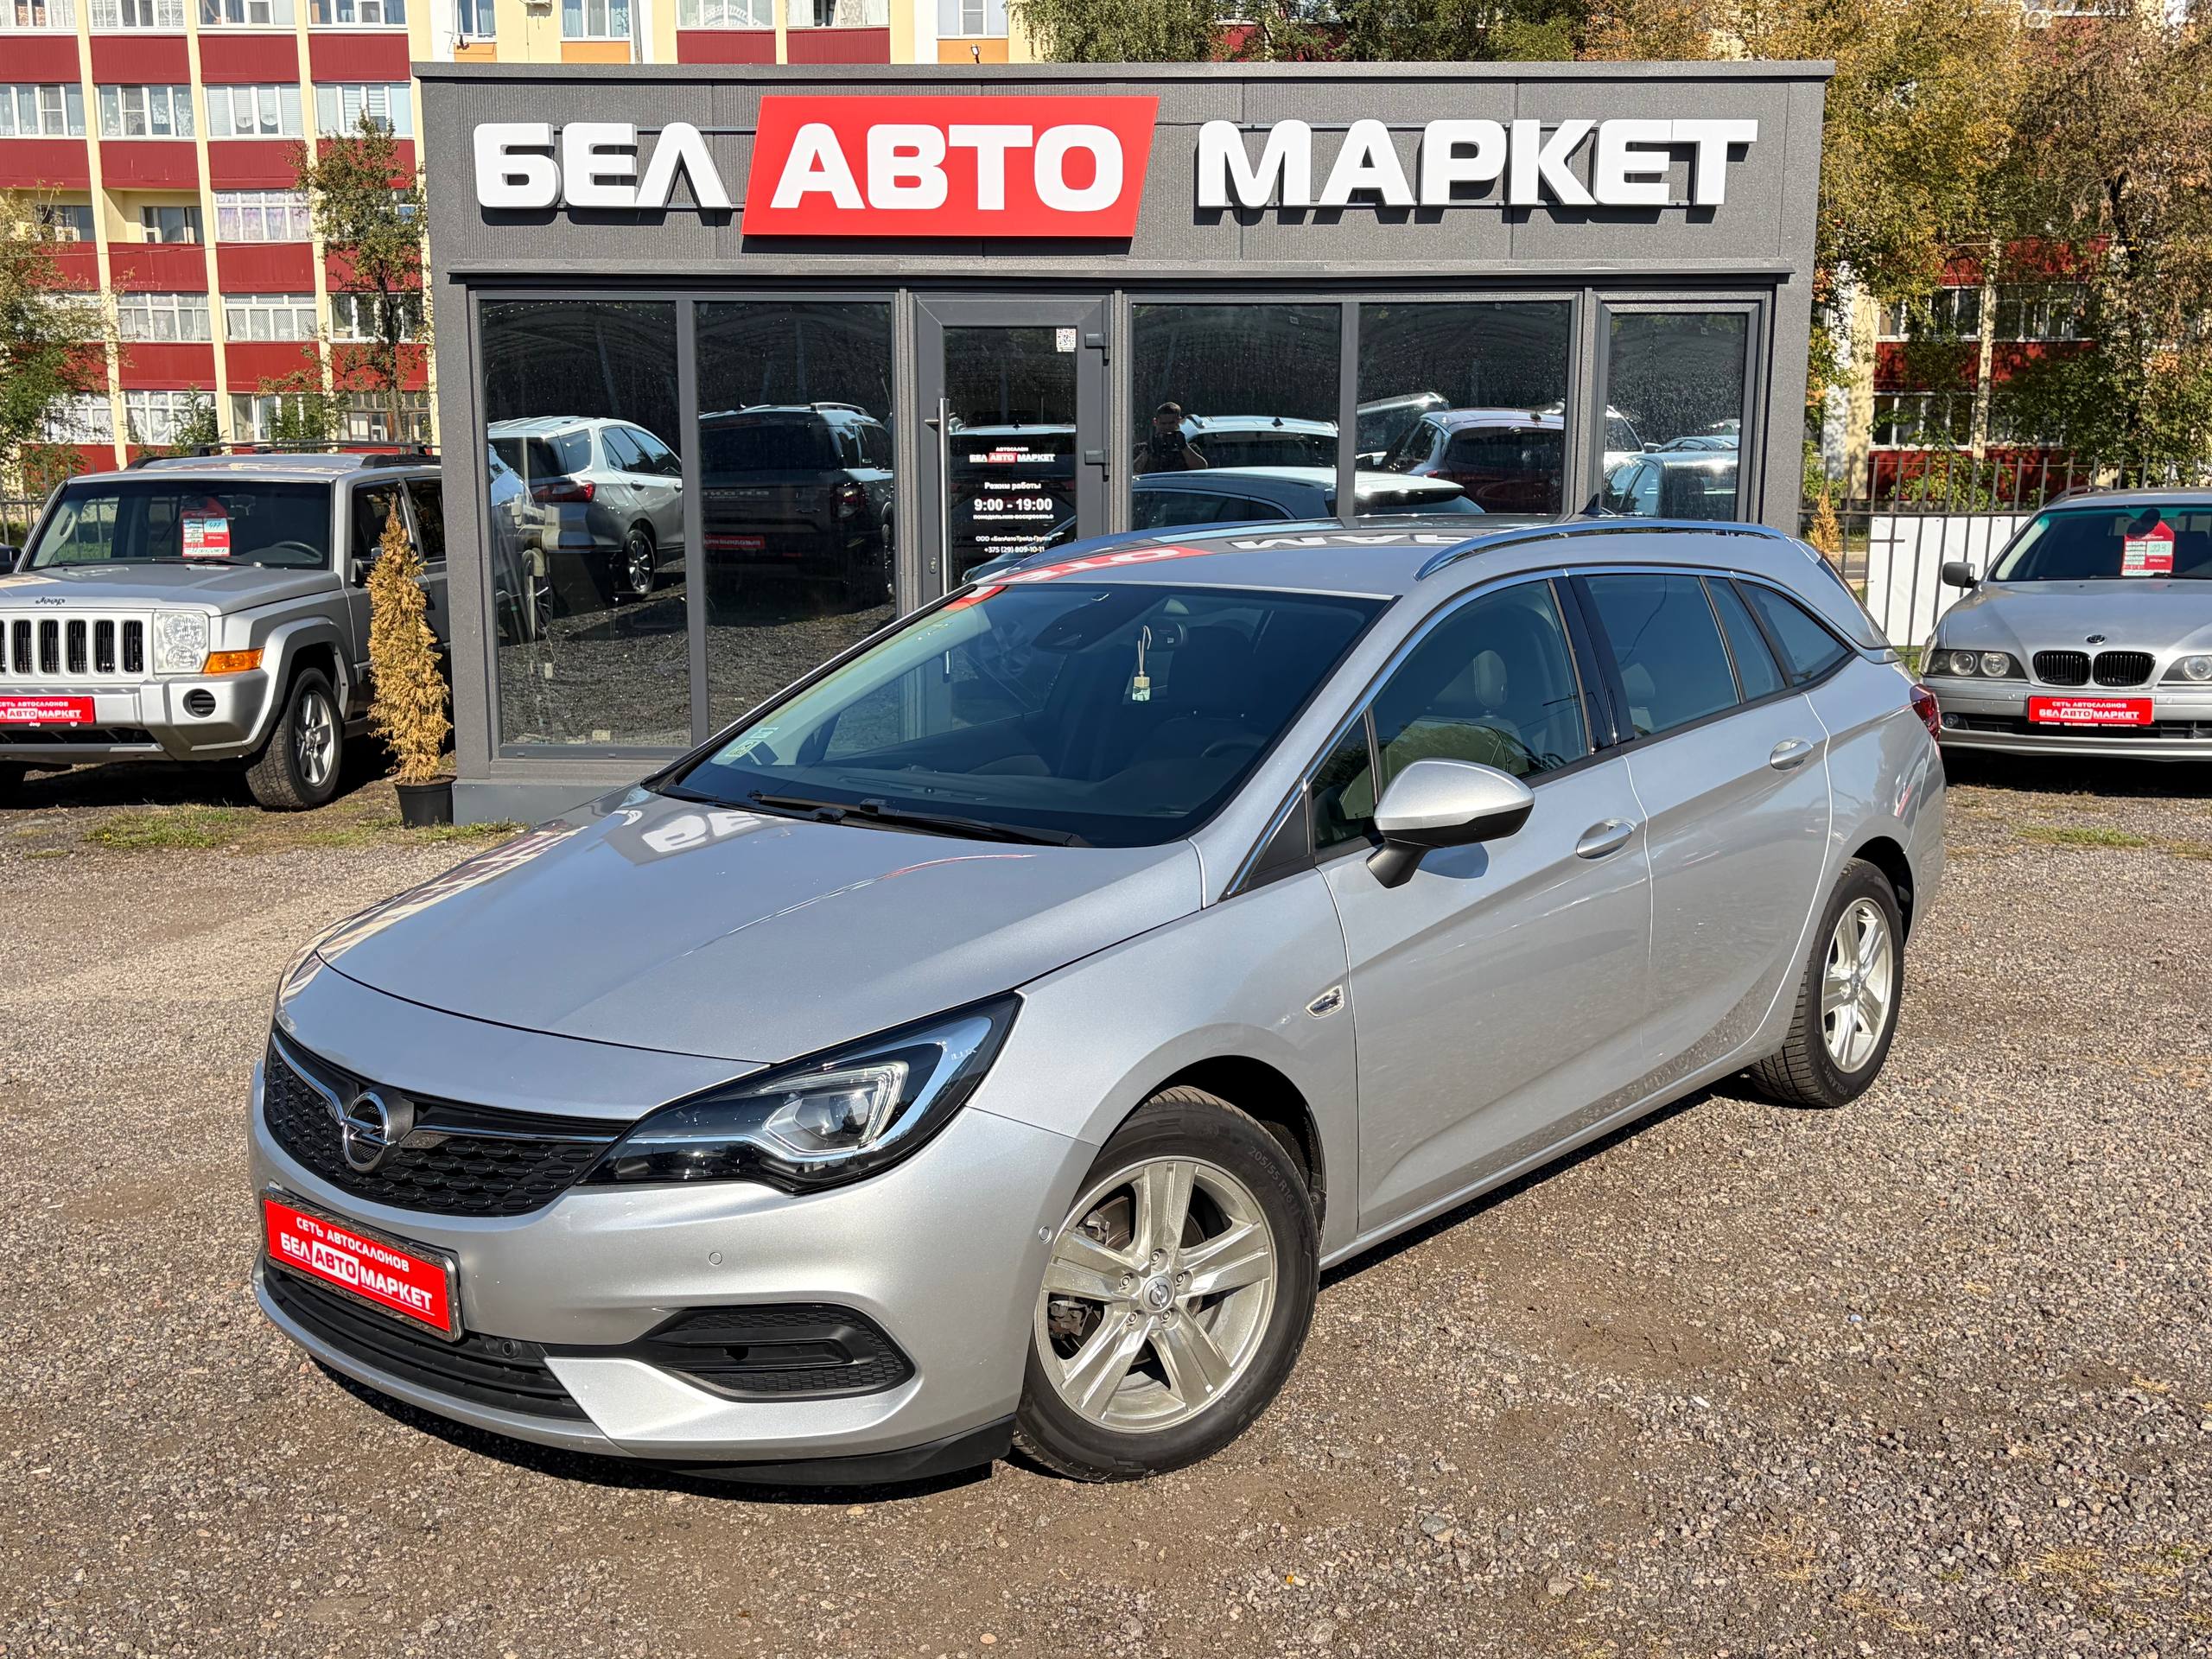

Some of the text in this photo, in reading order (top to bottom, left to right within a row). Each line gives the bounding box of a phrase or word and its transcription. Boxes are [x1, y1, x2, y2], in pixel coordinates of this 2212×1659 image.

[474, 119, 1759, 212] БЕЛ АВТО МАРКЕТ
[1017, 454, 1056, 462] МАРКЕТ
[984, 481, 1041, 491] Режим работы
[974, 498, 1003, 512] 9:00
[1015, 498, 1053, 512] 19:00
[38, 709, 82, 719] МАРКЕТ
[2093, 710, 2139, 720] МАРКЕТ
[1248, 1146, 1281, 1180] 205/55
[296, 1217, 410, 1273] СЕТЬ АВТОСАЛОНОВ
[280, 1232, 433, 1311] БЕЛ АВТО МАРКЕТ
